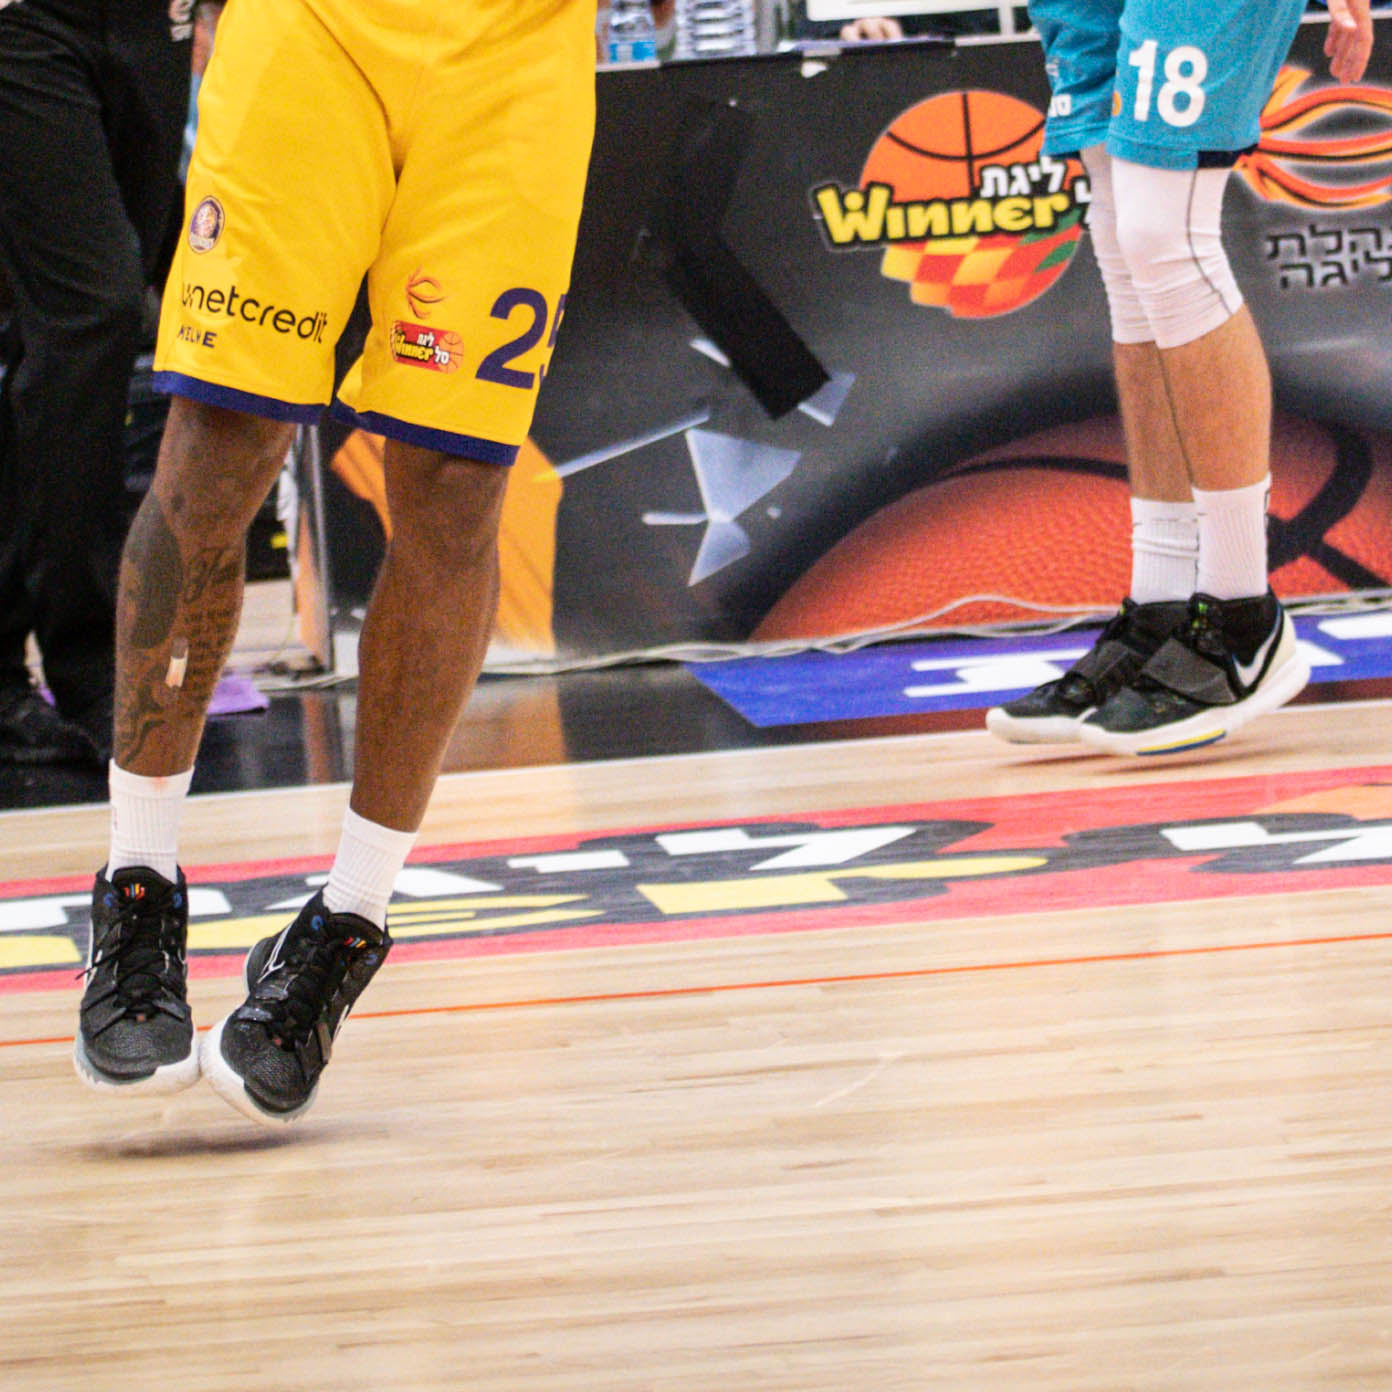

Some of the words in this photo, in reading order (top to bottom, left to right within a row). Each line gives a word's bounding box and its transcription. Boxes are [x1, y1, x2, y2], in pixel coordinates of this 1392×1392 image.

[1128, 39, 1208, 128] 18
[978, 156, 1066, 200] ליגת
[815, 181, 1072, 247] Winner
